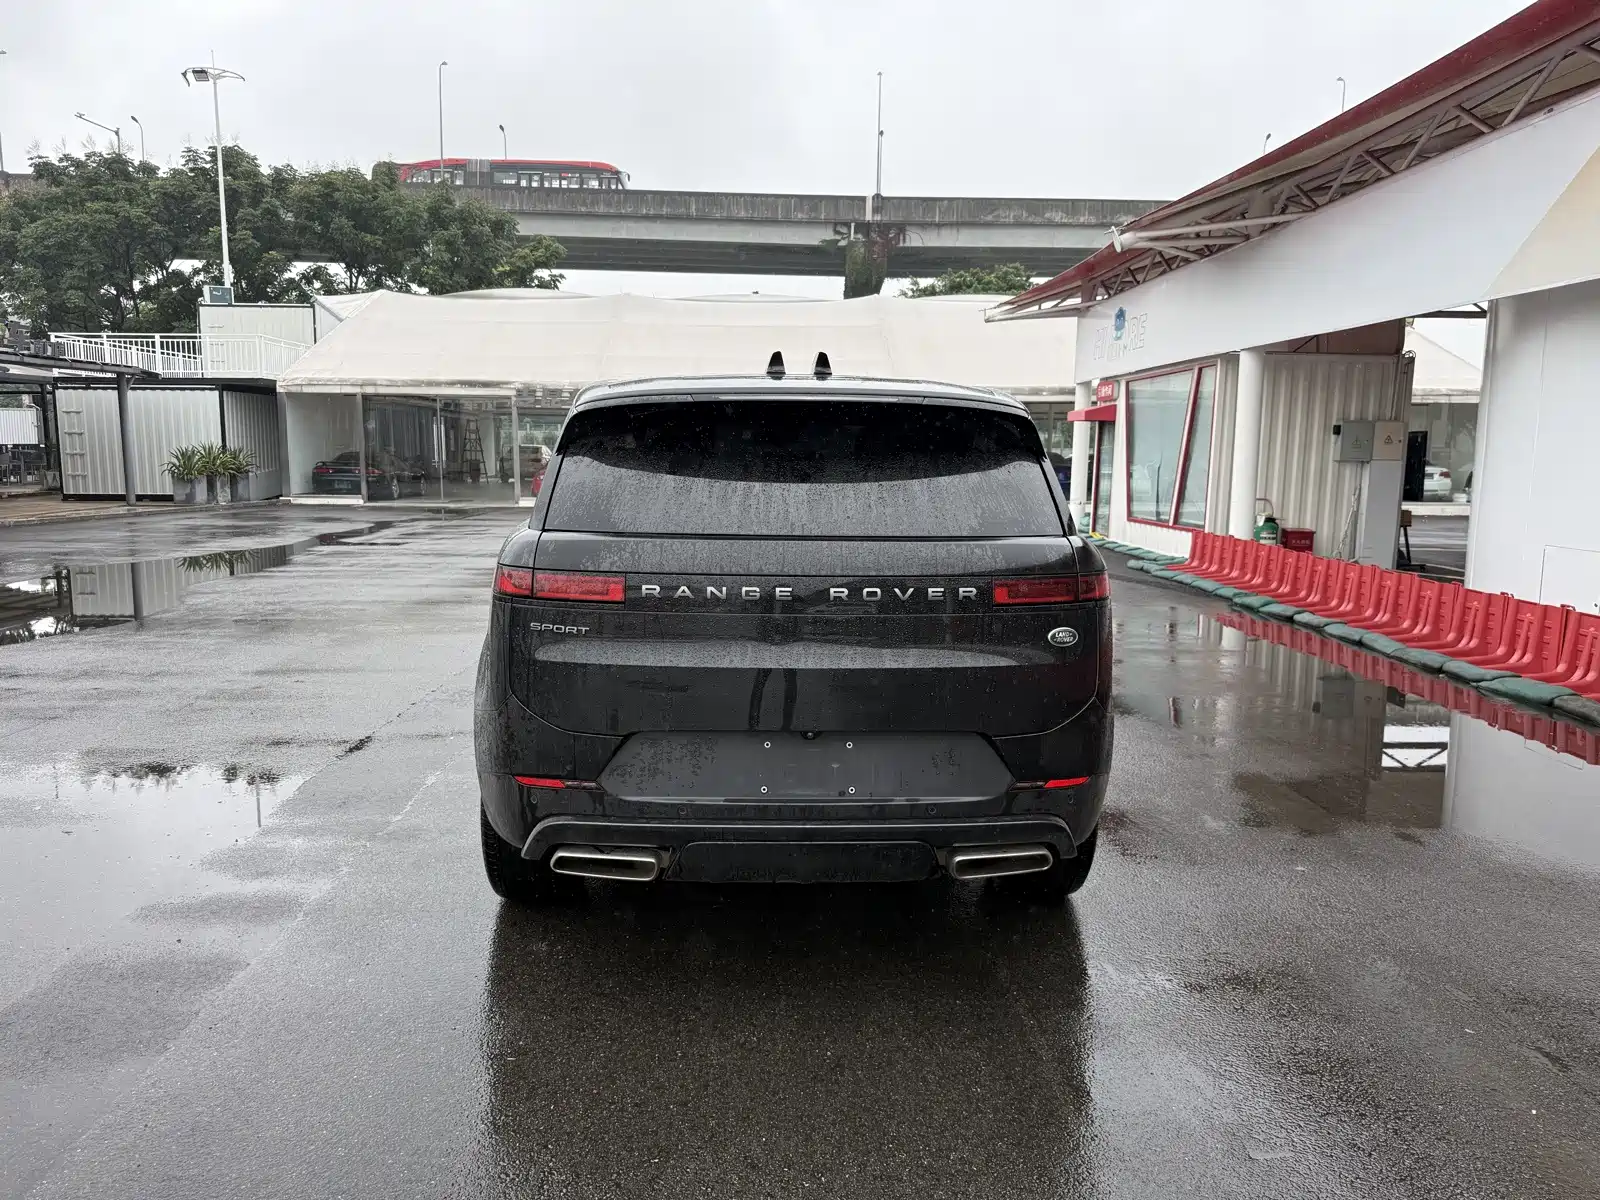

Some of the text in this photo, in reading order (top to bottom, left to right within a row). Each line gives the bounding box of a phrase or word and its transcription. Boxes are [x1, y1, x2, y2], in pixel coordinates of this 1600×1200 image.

[641, 584, 978, 601] RANGE ROVER
[530, 622, 590, 635] SPORT
